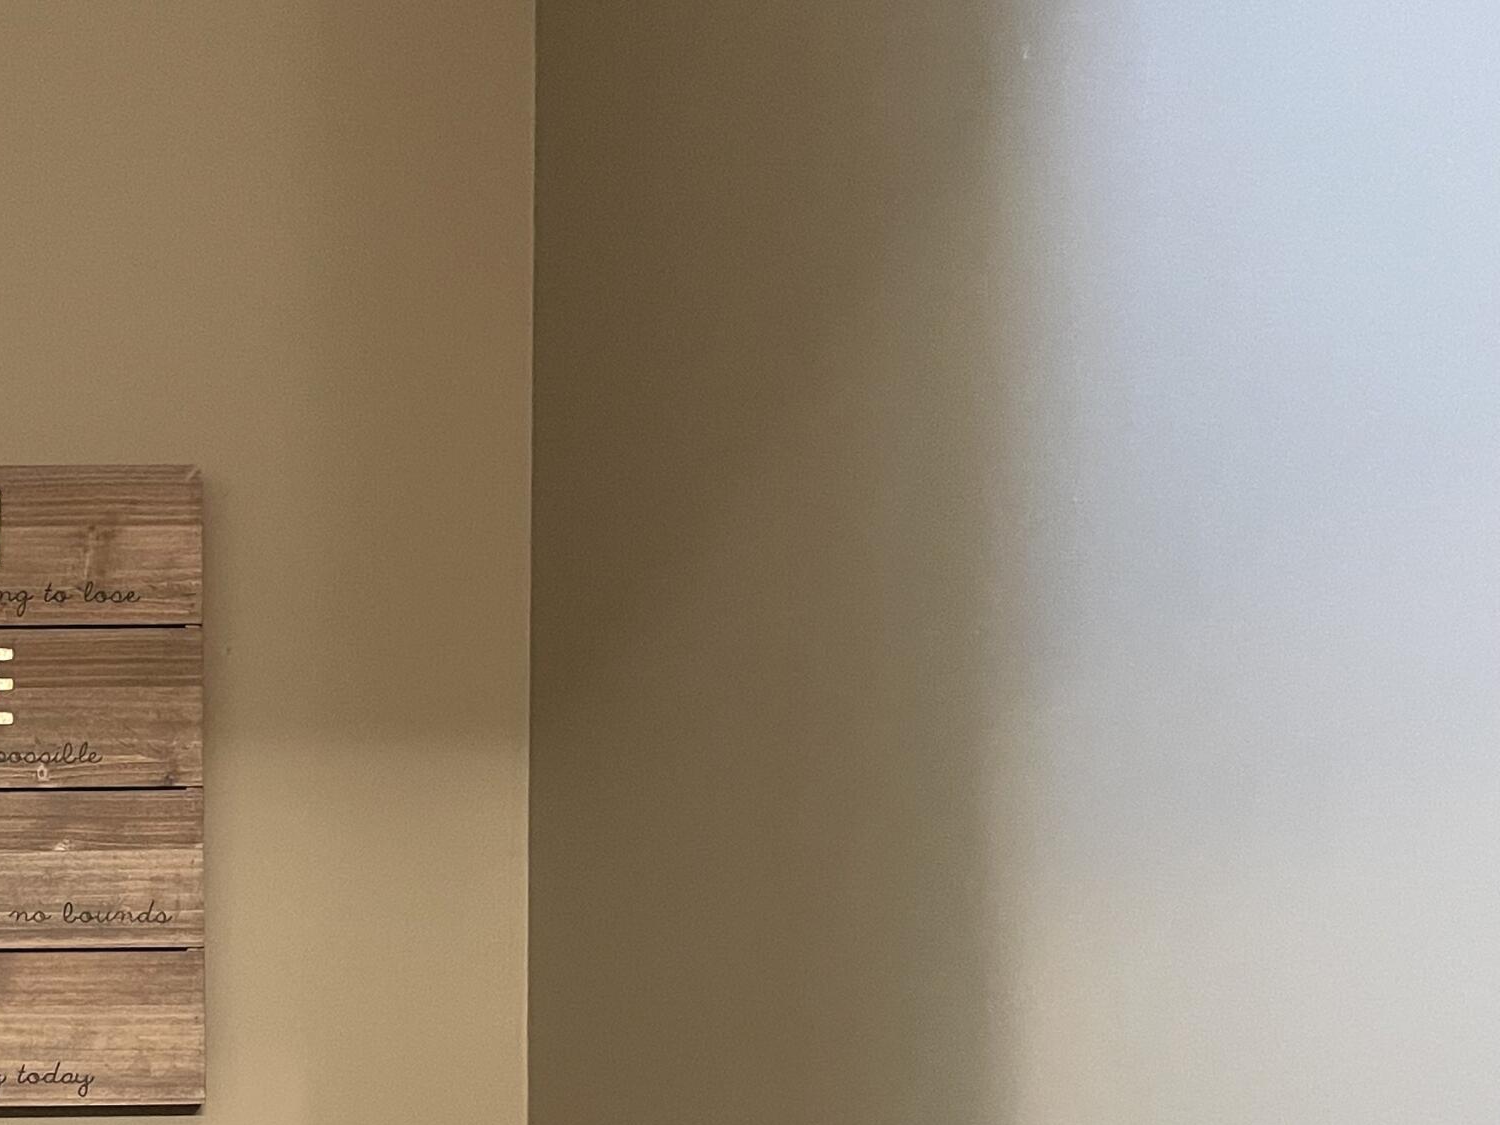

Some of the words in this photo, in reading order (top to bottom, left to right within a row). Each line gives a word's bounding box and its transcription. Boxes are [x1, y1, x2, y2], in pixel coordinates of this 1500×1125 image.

[43, 581, 67, 603] to
[82, 581, 142, 603] lose
[9, 906, 52, 924] no
[62, 899, 173, 924] bounds
[16, 1063, 95, 1097] today
